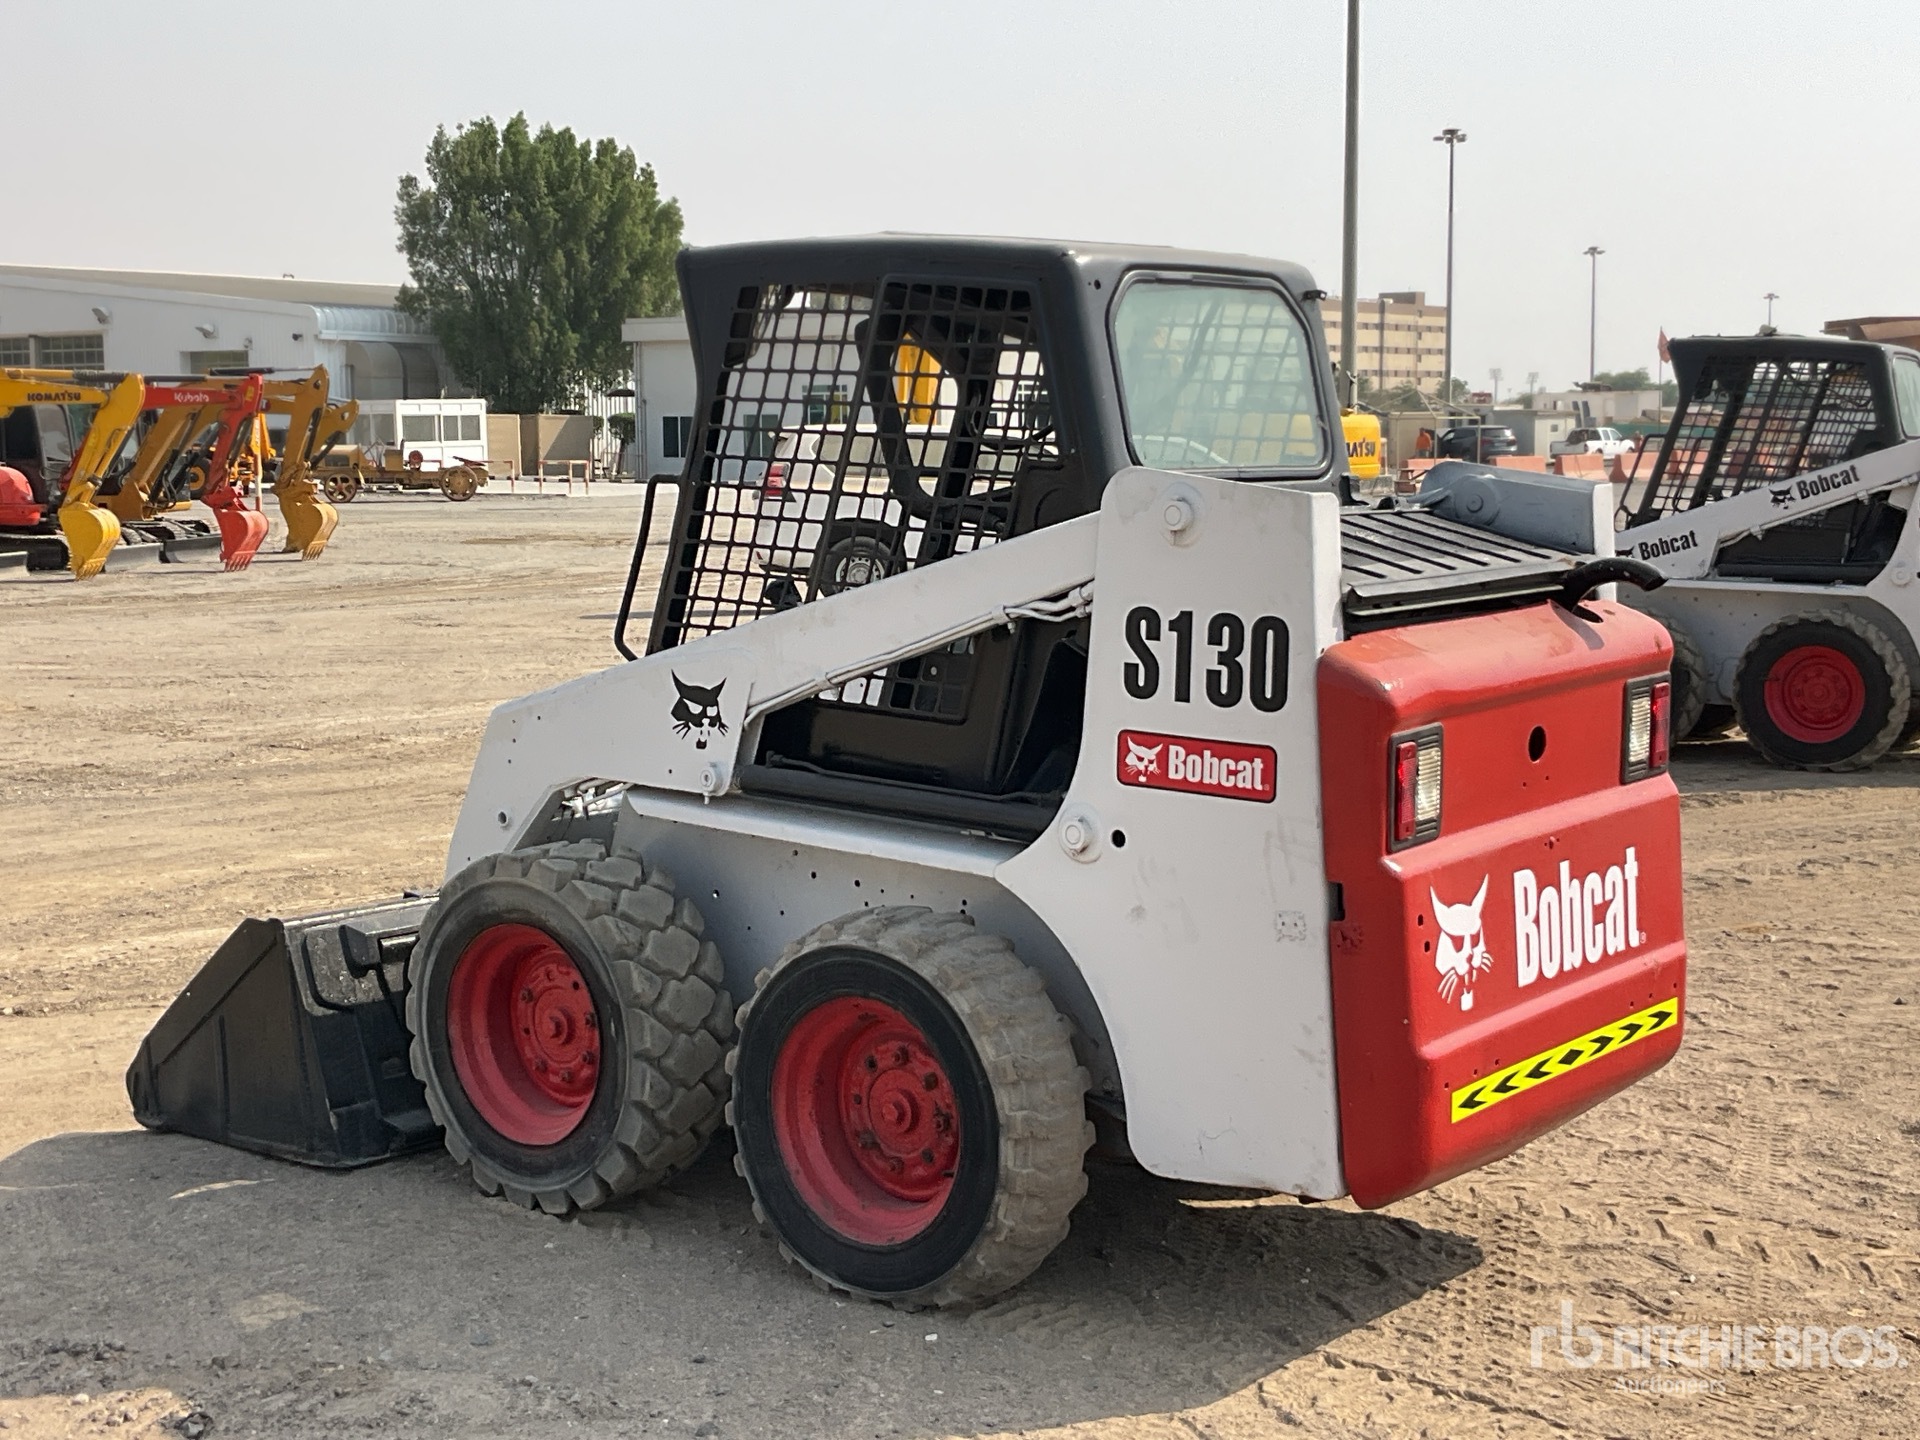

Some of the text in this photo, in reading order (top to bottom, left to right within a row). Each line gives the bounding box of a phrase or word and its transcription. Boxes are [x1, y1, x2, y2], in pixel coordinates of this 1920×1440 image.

[27, 391, 81, 401] KOMATSU
[174, 392, 209, 402] Kubota
[1796, 465, 1860, 500] Bobcat
[1638, 530, 1698, 561] Bobcat
[1124, 606, 1289, 713] S130
[1168, 744, 1263, 791] Bobcat
[1513, 846, 1639, 988] Bobcat
